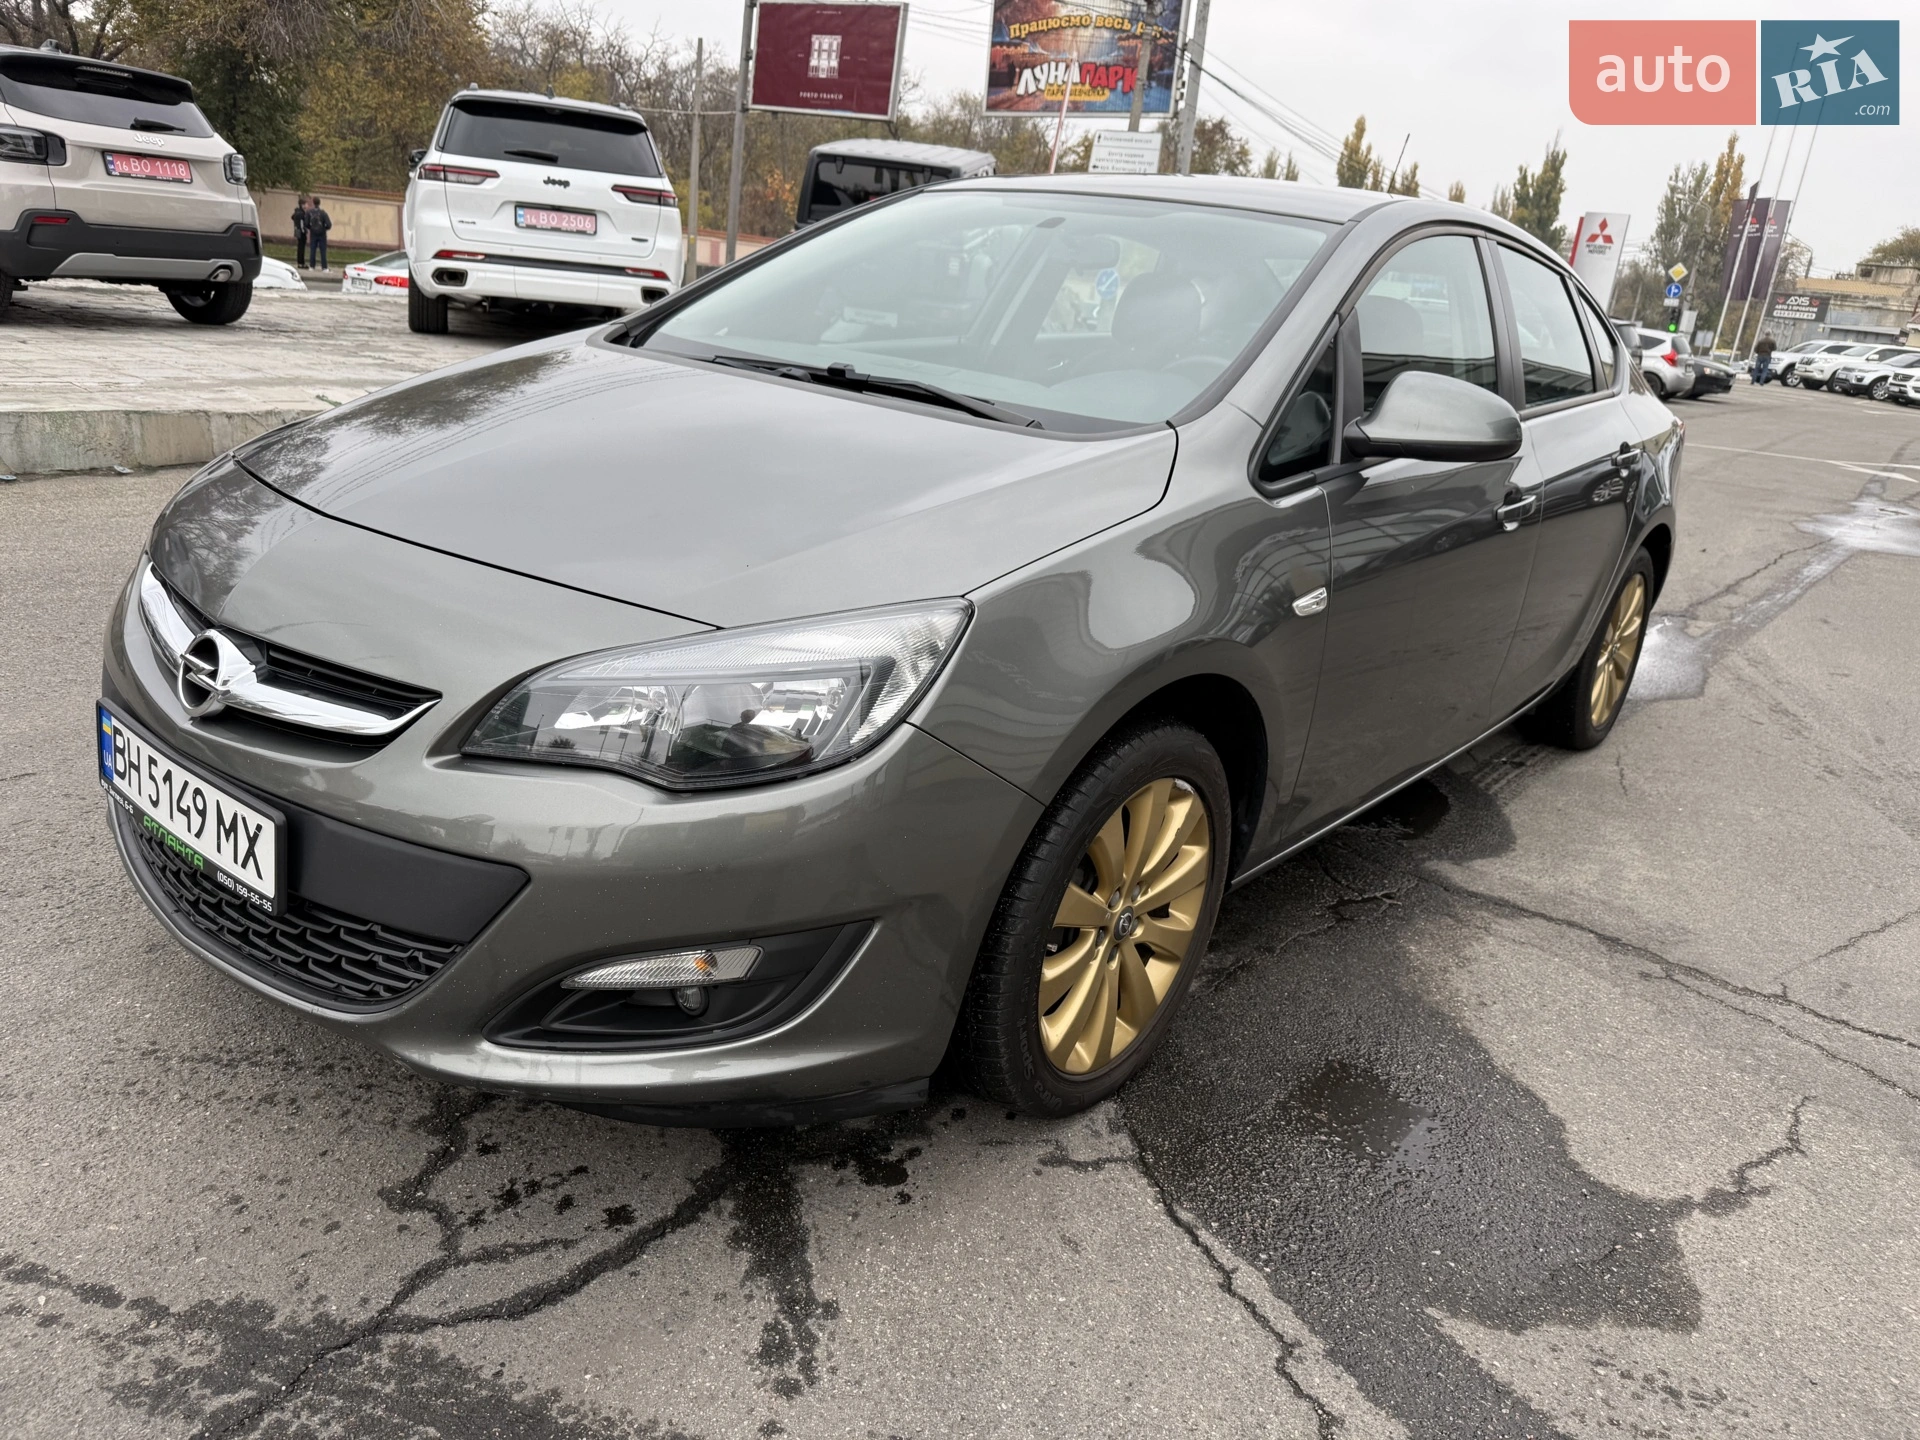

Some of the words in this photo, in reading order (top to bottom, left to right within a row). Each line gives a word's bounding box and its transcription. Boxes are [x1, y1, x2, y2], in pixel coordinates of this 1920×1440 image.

[1009, 15, 1091, 39] Працюємо
[1094, 16, 1131, 31] весь
[134, 133, 165, 147] Jeep
[115, 160, 129, 172] 16
[155, 161, 187, 177] 1118
[543, 176, 570, 189] Jeep
[526, 214, 537, 223] 16
[562, 214, 592, 229] 2506
[1786, 296, 1810, 306] ADIS
[103, 749, 113, 771] UA
[148, 754, 207, 840] 5149
[143, 815, 204, 870] АТЛАНТА
[217, 870, 234, 891] (050)
[235, 883, 273, 912] 159-55-55
